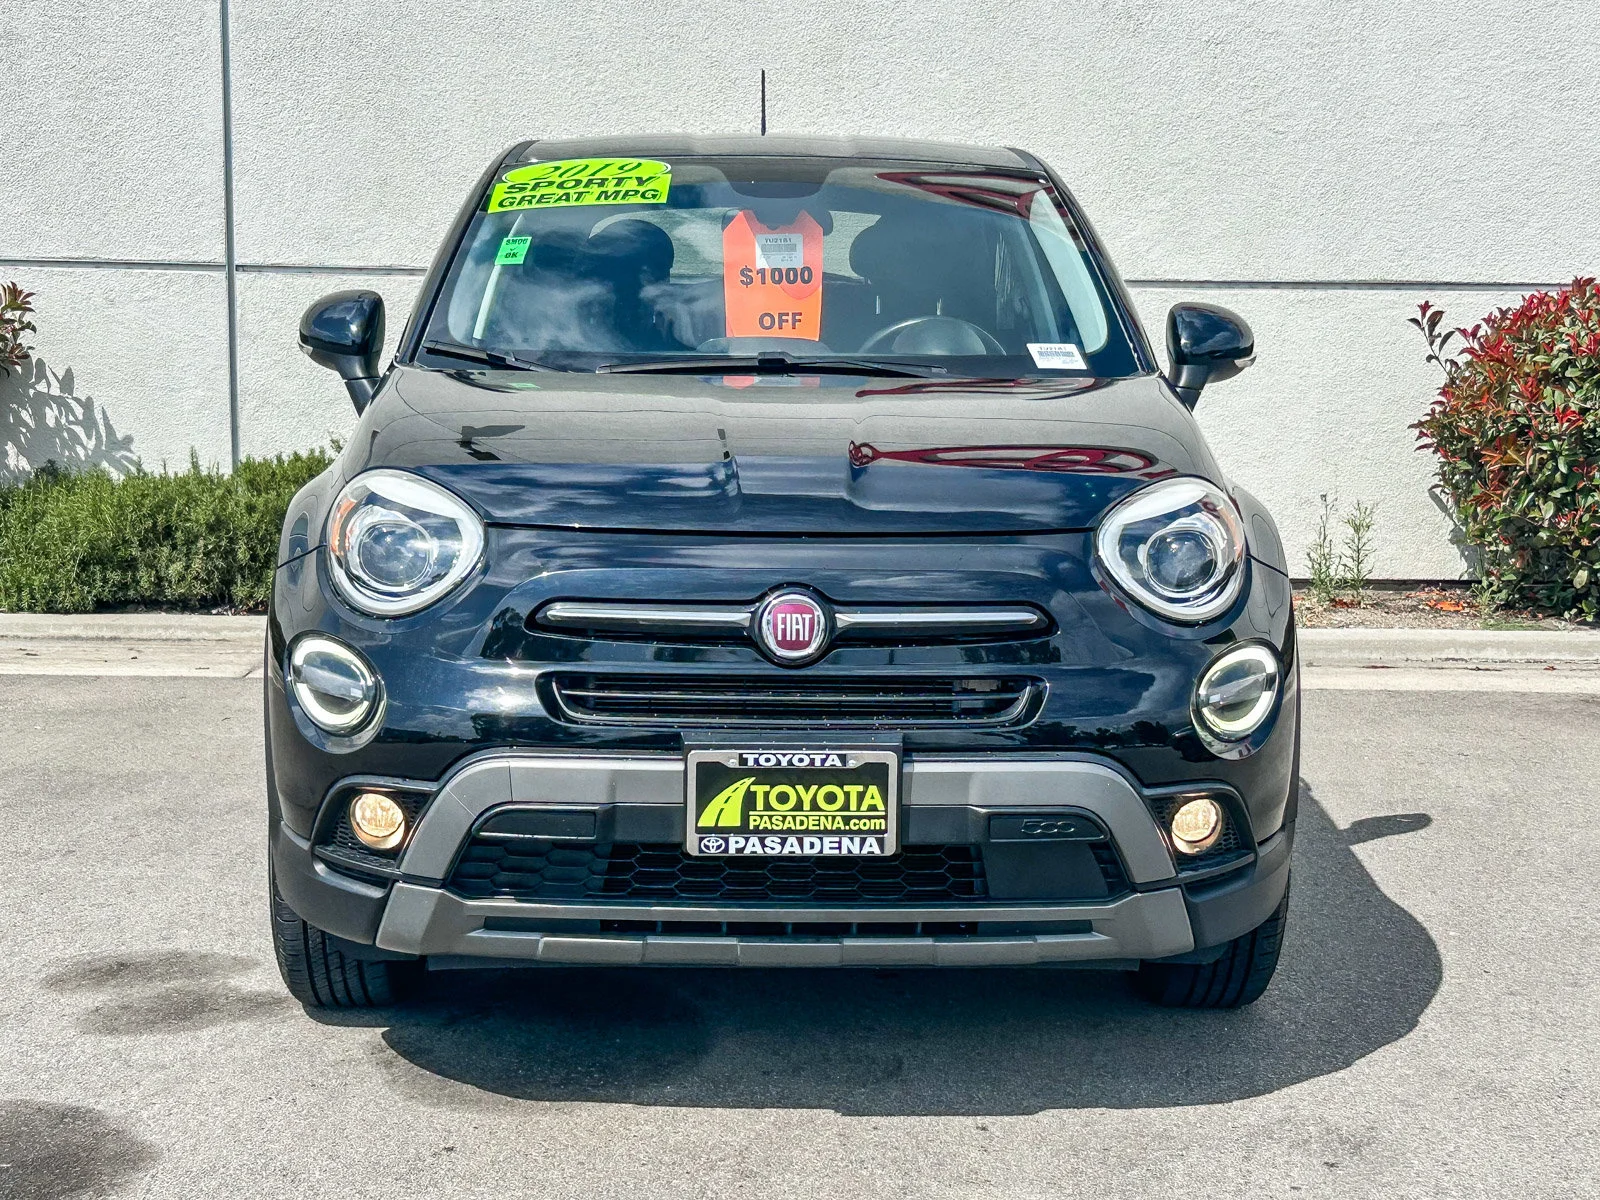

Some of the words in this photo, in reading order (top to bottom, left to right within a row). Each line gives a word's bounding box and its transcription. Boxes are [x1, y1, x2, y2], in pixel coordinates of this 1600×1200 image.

[530, 162, 642, 181] 2019
[503, 175, 658, 194] SPORTY
[497, 191, 590, 208] GREAT
[595, 188, 662, 202] MPG
[740, 265, 813, 288] $1000
[758, 312, 803, 331] OFF
[777, 613, 812, 641] FIAT
[742, 753, 843, 767] TOYOTA
[750, 784, 885, 811] TOYOTA
[749, 815, 886, 831] PASADENA.com
[1021, 818, 1076, 834] 500
[728, 836, 884, 855] PASADENA
